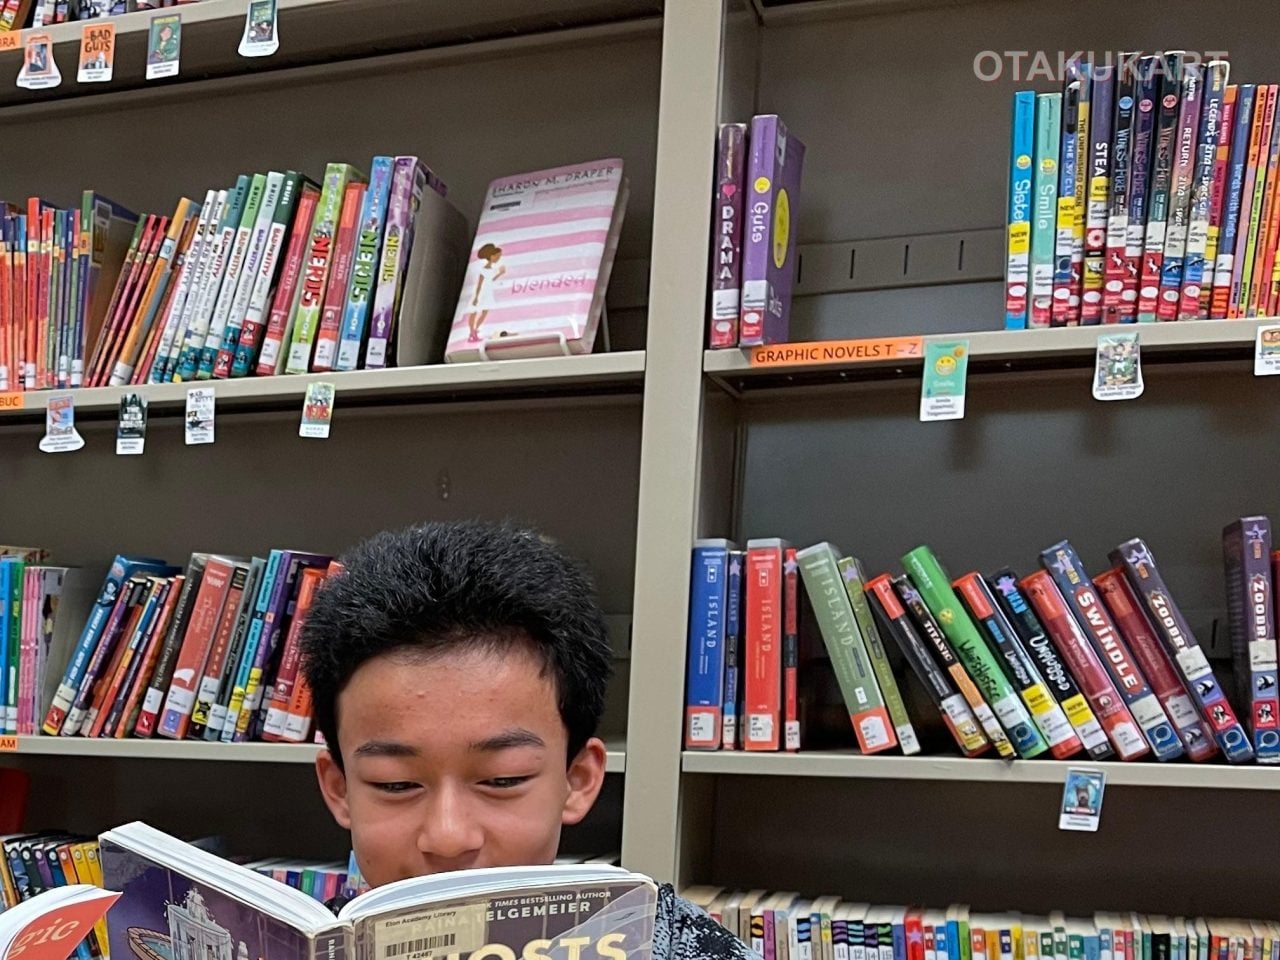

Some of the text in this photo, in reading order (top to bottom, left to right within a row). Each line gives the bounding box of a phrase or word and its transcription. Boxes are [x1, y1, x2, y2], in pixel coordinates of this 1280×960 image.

[85, 40, 111, 53] GUYS
[90, 30, 111, 41] BAD
[1076, 135, 1085, 183] UNFINISHED
[1094, 142, 1108, 177] STEA
[1114, 128, 1130, 193] WINGS FIRE
[1180, 127, 1193, 167] RETURN
[492, 180, 539, 194] SHARON
[565, 166, 613, 182] DRAPER
[1065, 177, 1073, 197] CLU
[1075, 184, 1083, 207] CORN
[751, 201, 769, 243] Guts
[1013, 179, 1031, 224] Siste
[1038, 184, 1055, 230] Smile
[1229, 192, 1240, 211] with
[720, 205, 735, 280] DRAMA
[300, 234, 332, 308] NERDS
[351, 230, 378, 303] NERDS
[511, 272, 587, 295] blended
[756, 343, 918, 363] GRAPHIC NOVELS T Z
[0, 396, 18, 406] BUC
[707, 595, 719, 649] ISLAND
[762, 599, 773, 652] ISLAND
[822, 578, 853, 647] ISLAND
[1150, 594, 1186, 652] ZOOBR
[1253, 580, 1267, 642] ZOOBR
[923, 620, 953, 663] TITANIC
[401, 914, 432, 925] Academy
[433, 911, 457, 920] Library
[494, 898, 519, 908] TIMES
[520, 893, 574, 906] BESTSELLING
[576, 891, 612, 900] AUTHOR
[838, 948, 846, 959] 11
